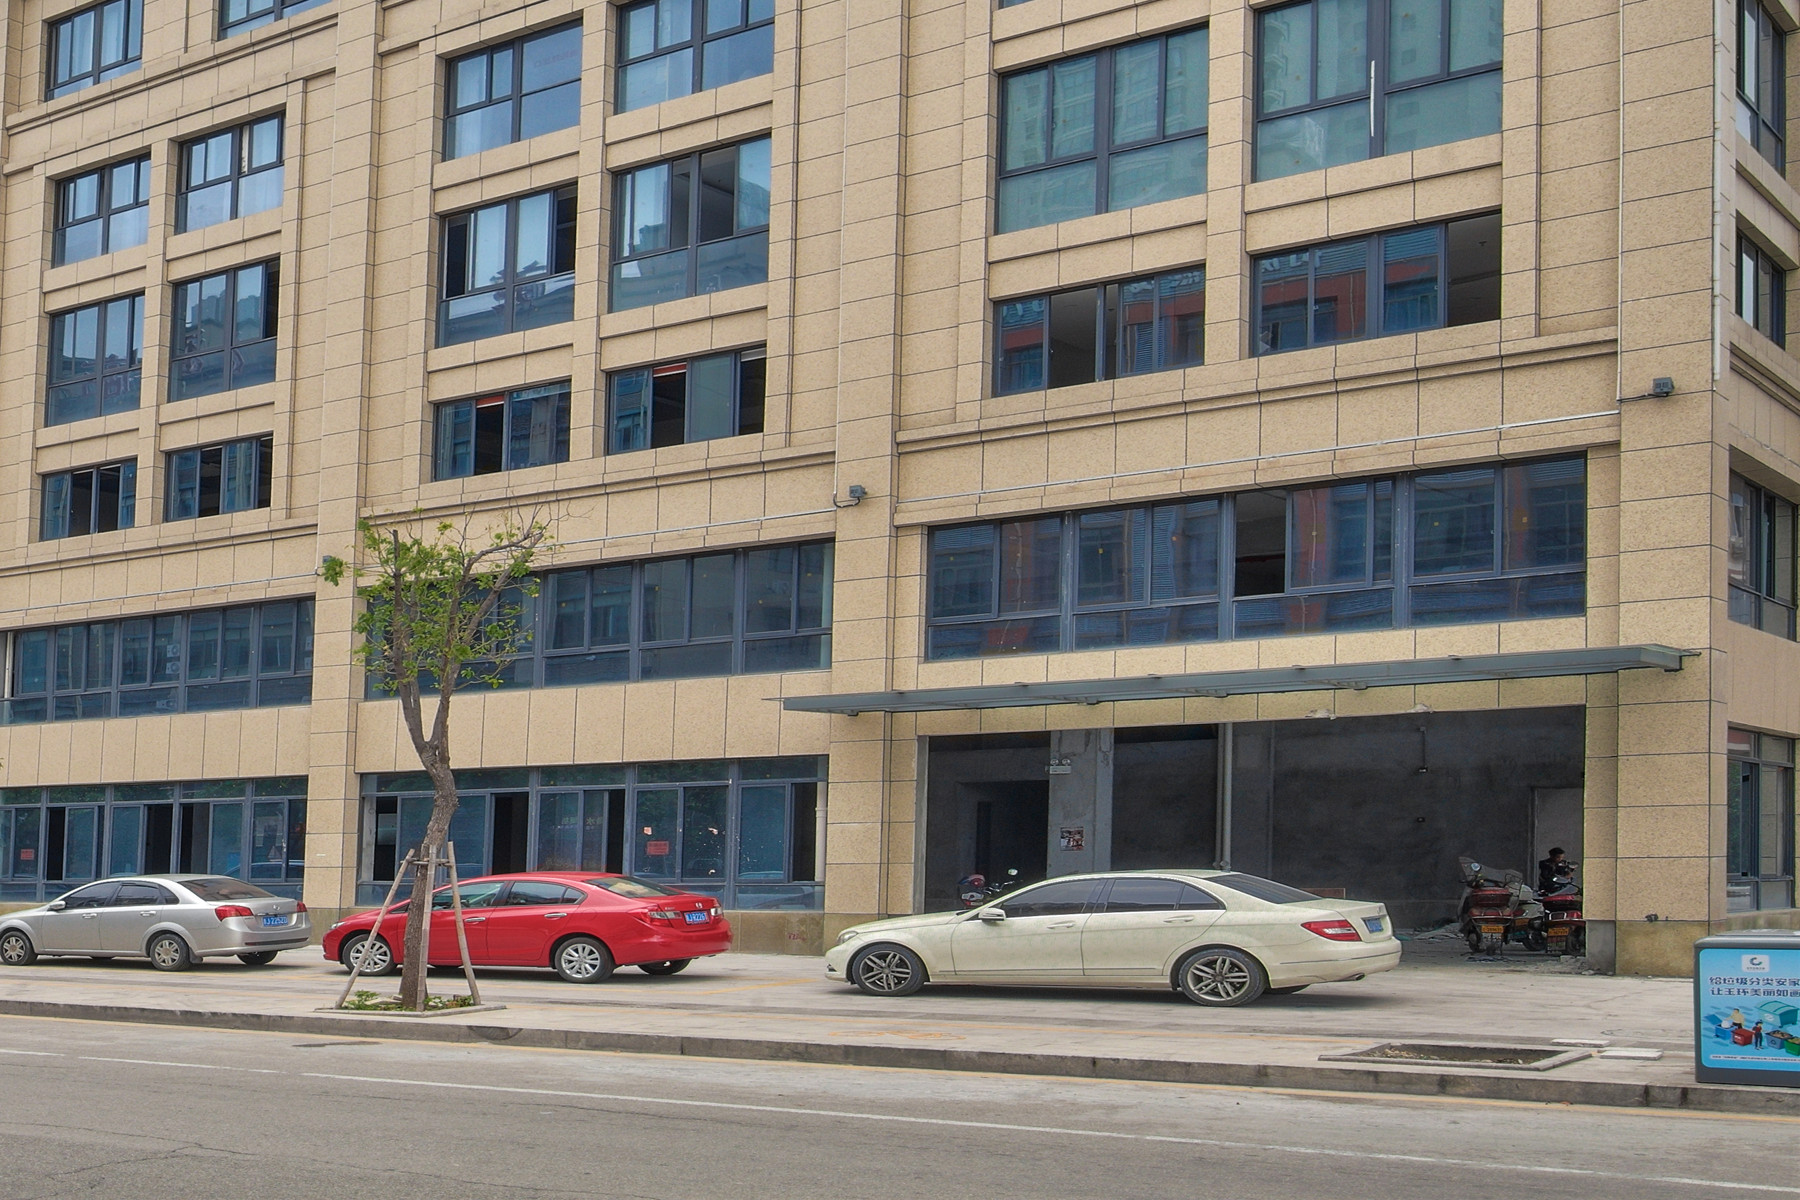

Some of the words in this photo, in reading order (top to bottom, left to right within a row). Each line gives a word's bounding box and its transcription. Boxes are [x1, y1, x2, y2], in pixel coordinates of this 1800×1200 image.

[1709, 976, 1800, 987] 给垃圾分类安家
